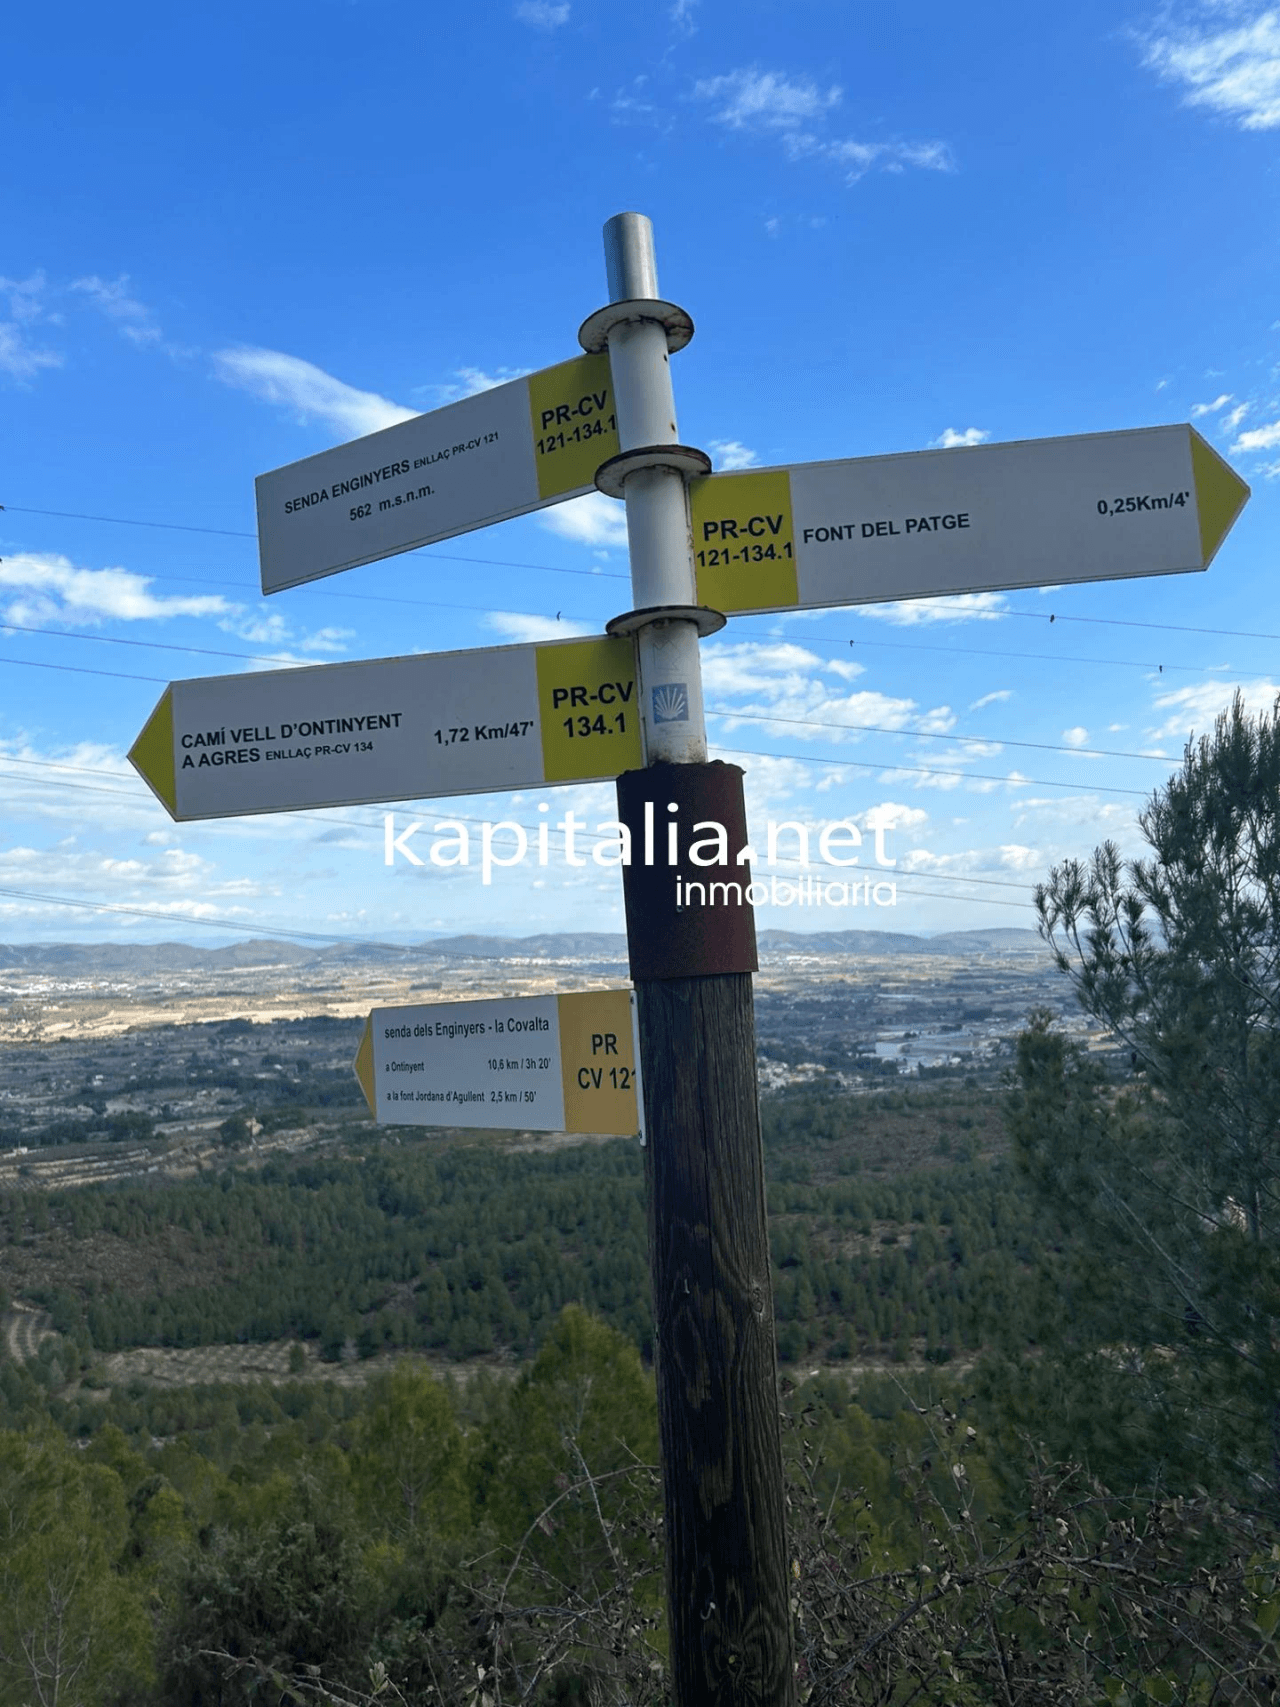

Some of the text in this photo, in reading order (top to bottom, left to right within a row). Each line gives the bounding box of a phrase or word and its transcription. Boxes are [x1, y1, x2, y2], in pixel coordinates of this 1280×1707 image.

[542, 390, 607, 430] PR-CV
[538, 413, 618, 456] 121-134.1
[285, 432, 498, 513] SENDA ENGINYERS ENLLAÇ PR-CV 121
[350, 486, 434, 521] 562 m.s.n.m.
[1097, 492, 1189, 516] 0,25Km/4'
[704, 515, 783, 541] PR-CV
[804, 513, 970, 543] FONT DEL PATGE
[697, 542, 792, 567] 121-134.1
[553, 681, 633, 709] PR-CV
[182, 713, 402, 748] CAMÍ VELL D'ONTINYENT
[435, 721, 533, 746] 1,72 Km/47'
[564, 712, 625, 737] 134.1
[182, 742, 373, 769] A AGRES ENLLAÇ PR-CV 134
[385, 1025, 411, 1038] senda
[414, 1024, 432, 1037] dels
[436, 1022, 485, 1038] Enginyers
[495, 1019, 504, 1032] la
[507, 1017, 549, 1032] Covalta
[592, 1034, 618, 1055] PR
[385, 1063, 390, 1073] a
[392, 1062, 424, 1073] Ontinyent
[488, 1059, 504, 1071] 10,6
[507, 1060, 518, 1069] km
[526, 1058, 536, 1069] 3h
[539, 1058, 550, 1069] 20'
[578, 1068, 602, 1089] CV
[386, 1092, 392, 1101] a
[392, 1090, 399, 1101] la
[400, 1091, 414, 1100] font
[416, 1092, 444, 1101] Jordana
[491, 1091, 502, 1102] 2,5
[505, 1092, 517, 1101] km
[525, 1091, 536, 1102] 50'
